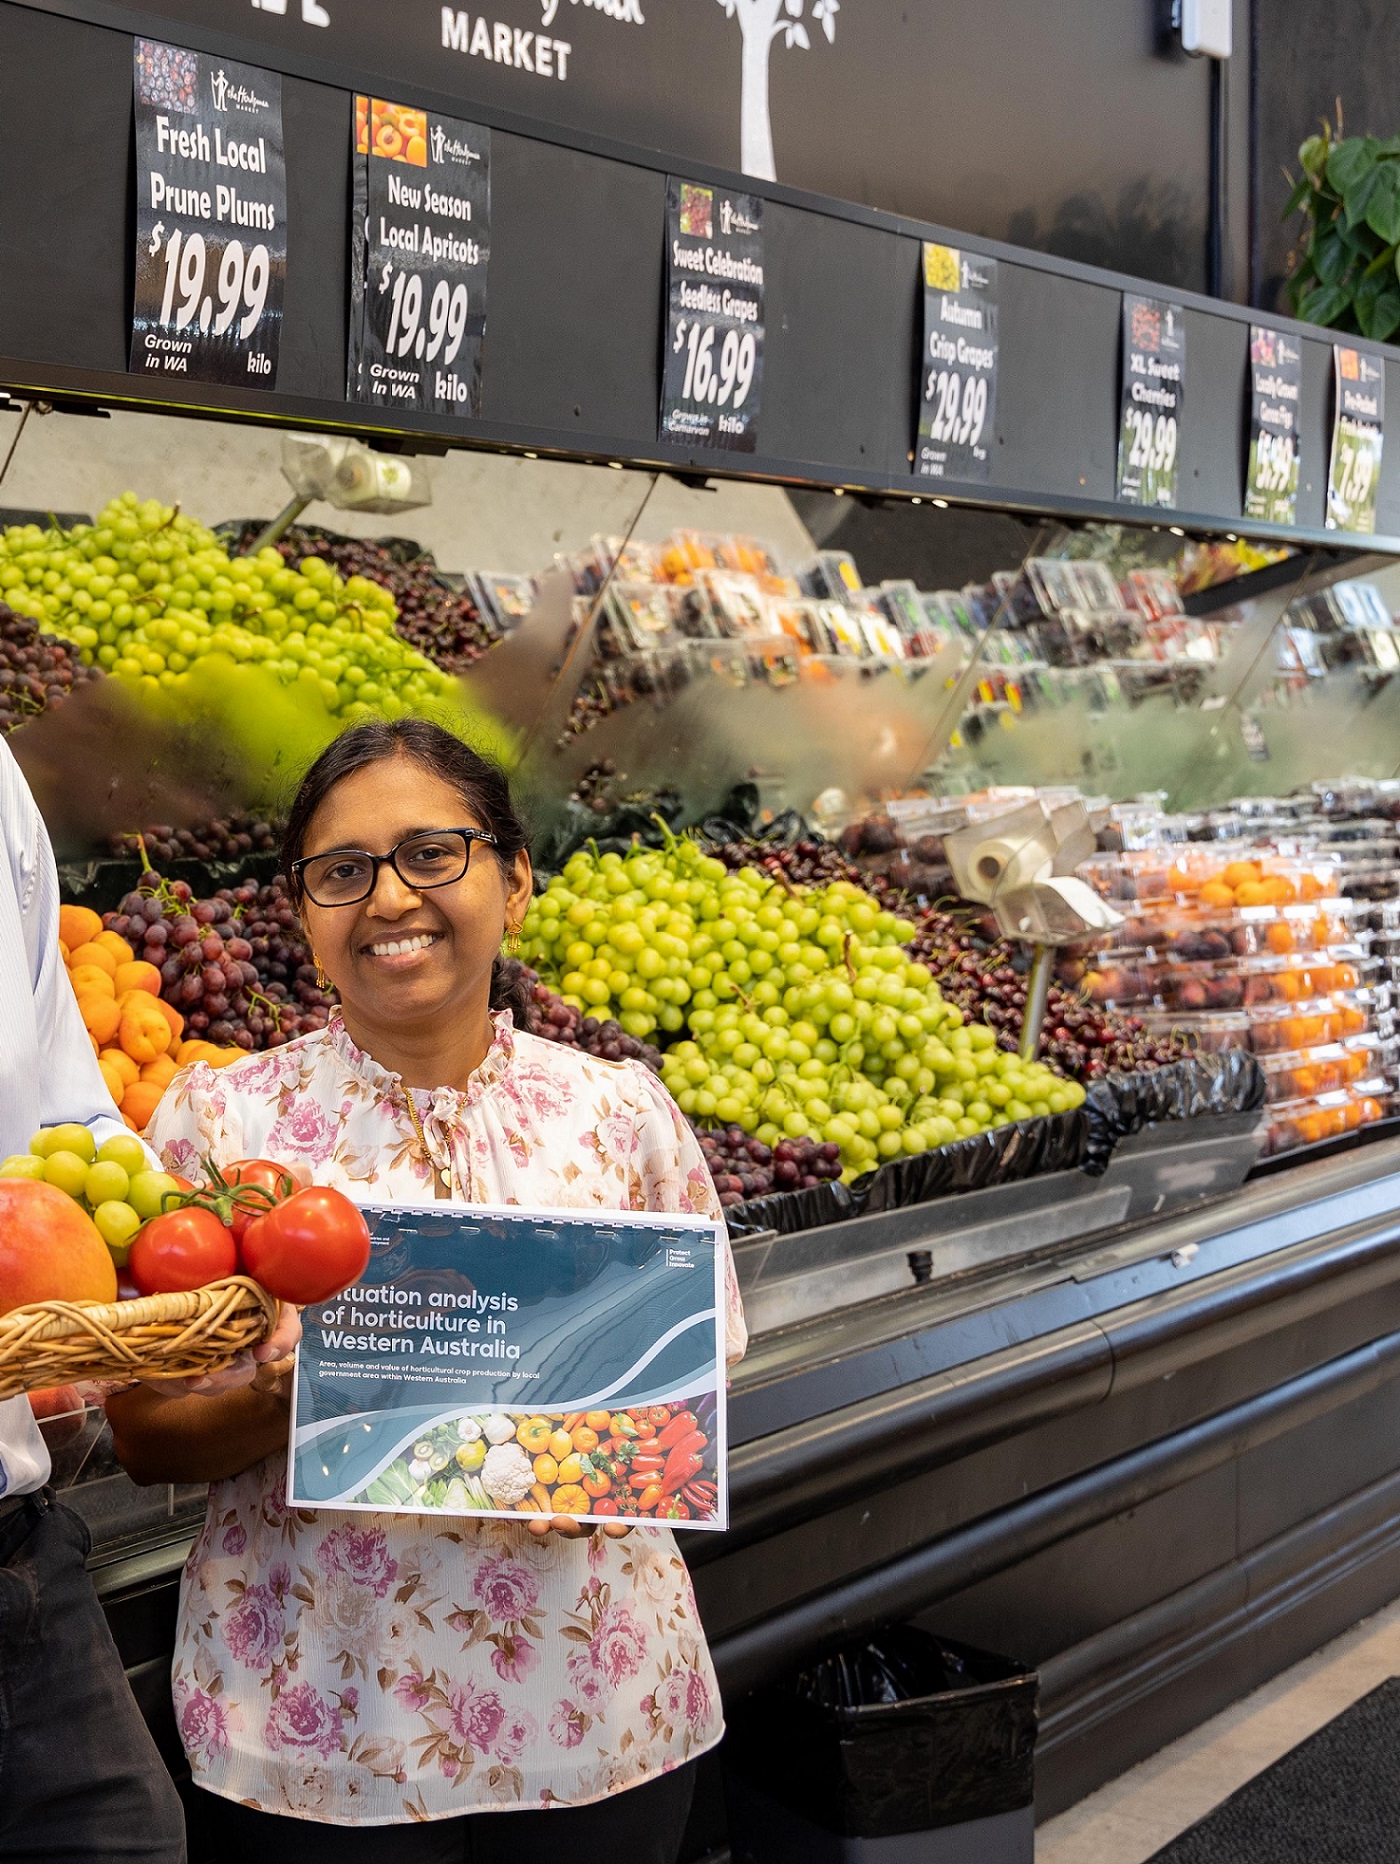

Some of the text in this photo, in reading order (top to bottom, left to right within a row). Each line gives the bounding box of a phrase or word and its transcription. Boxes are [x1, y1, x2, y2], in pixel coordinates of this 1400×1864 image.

[441, 6, 571, 81] MARKET
[156, 115, 267, 174] Fresh Local
[150, 171, 275, 231] Prune Plums
[388, 174, 471, 221] New Season
[380, 216, 479, 265] Local Apricots
[673, 240, 763, 285] Sweet Celebration
[680, 280, 758, 324] Seedless Grapes
[940, 295, 982, 329] Autumn
[144, 334, 192, 354] Grown
[930, 330, 993, 371] Crisp Grapes
[145, 354, 187, 372] in WA
[247, 351, 271, 375] kilo
[370, 363, 420, 383] Grown
[1131, 353, 1146, 374] XL
[372, 381, 416, 399] In WA
[435, 371, 467, 402] kilo
[718, 414, 745, 434] kilo
[921, 447, 947, 462] Grown
[331, 1286, 519, 1314] ituation analysis
[321, 1306, 506, 1334] of horticulture in
[321, 1330, 520, 1359] Western Australia
[319, 1360, 338, 1369] Area,
[339, 1361, 364, 1369] volume
[410, 1365, 454, 1374] horticultural
[455, 1368, 471, 1376] crop
[472, 1368, 510, 1378] production
[512, 1371, 521, 1380] by
[522, 1371, 540, 1379] local
[319, 1369, 361, 1378] government
[404, 1374, 433, 1382] Western
[434, 1376, 466, 1384] Australia
